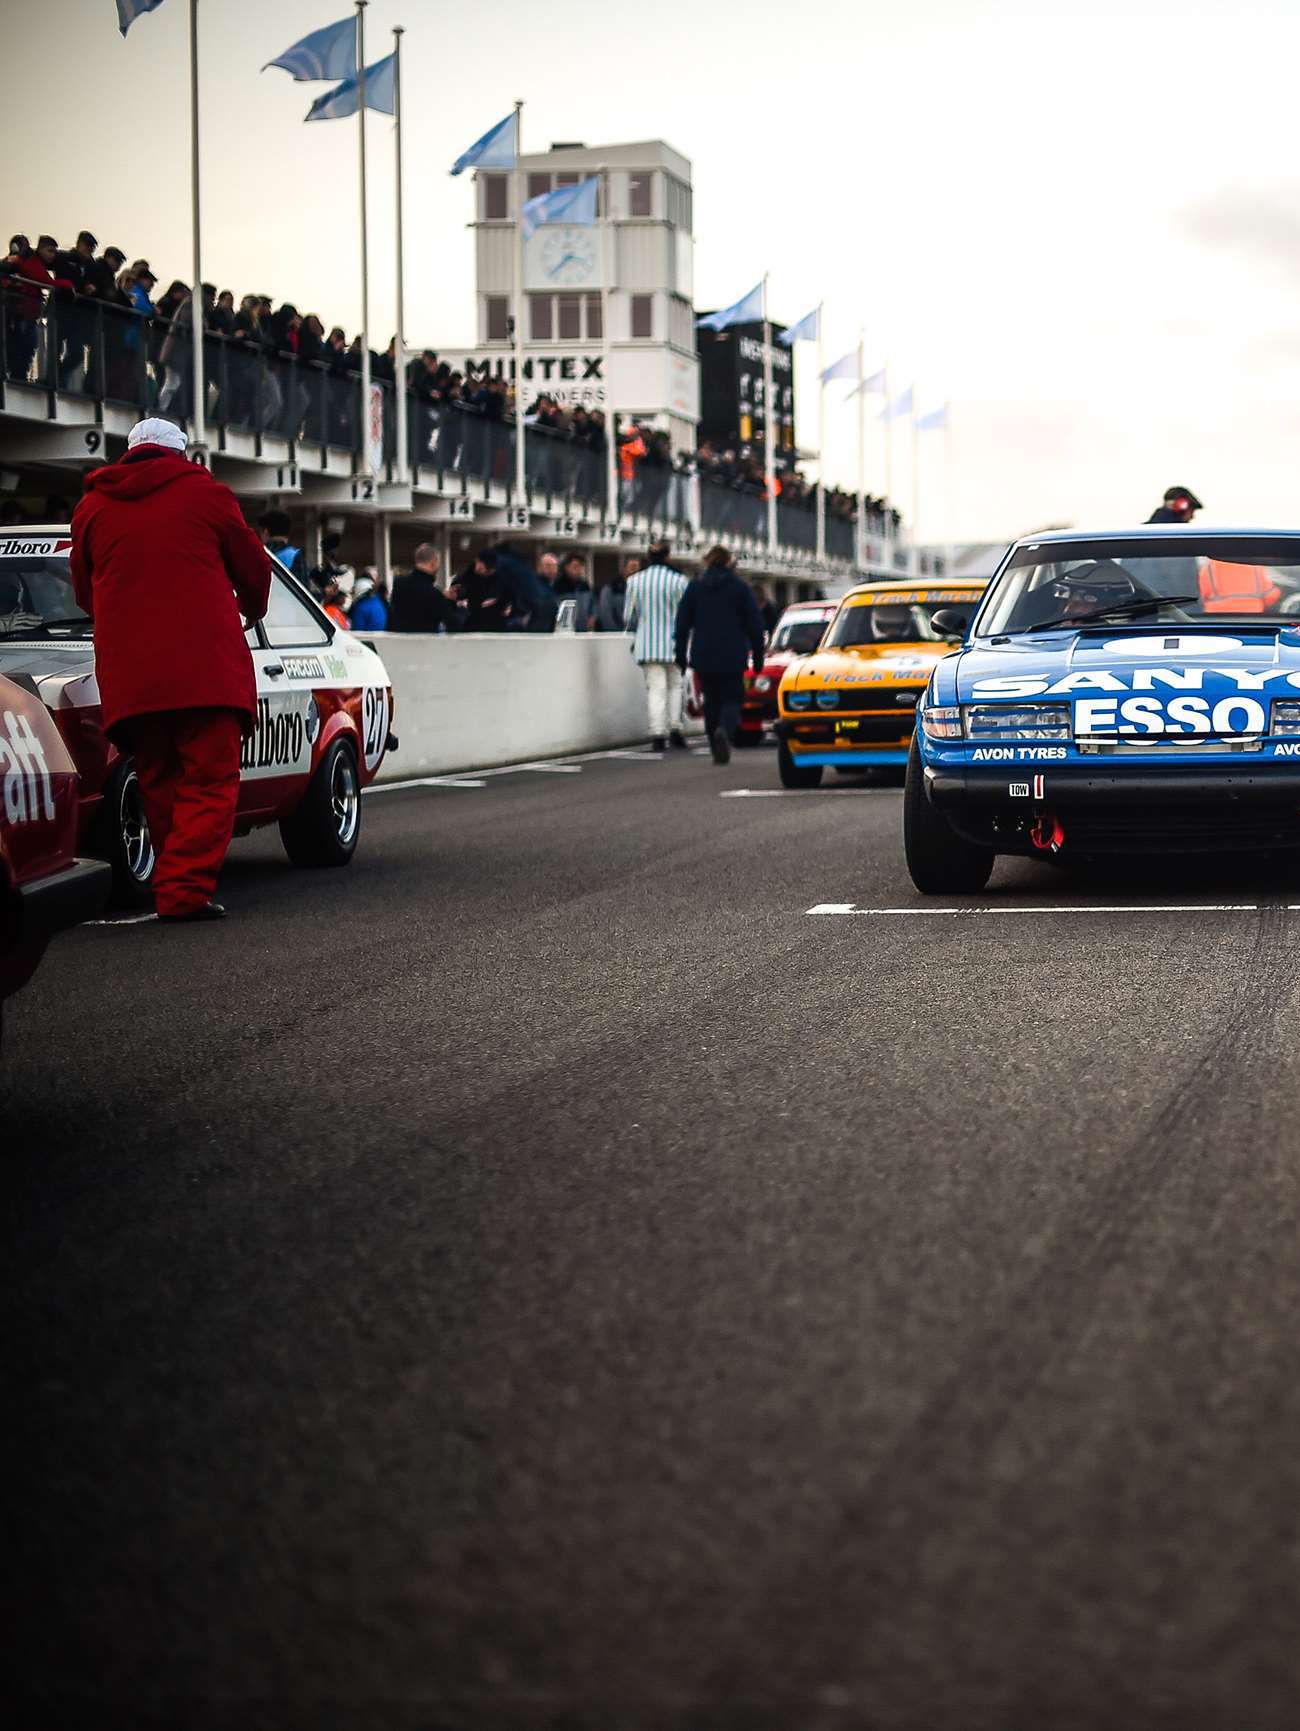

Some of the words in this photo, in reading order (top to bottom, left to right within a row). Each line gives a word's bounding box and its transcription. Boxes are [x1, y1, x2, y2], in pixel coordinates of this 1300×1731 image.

[465, 356, 604, 381] MINTEX
[84, 430, 101, 454] 9
[277, 463, 297, 487] 11
[351, 477, 374, 501] 12
[1075, 696, 1266, 746] ESSO
[972, 748, 1015, 760] AVON
[1017, 747, 1067, 760] TYRES
[1010, 784, 1028, 796] TOW
